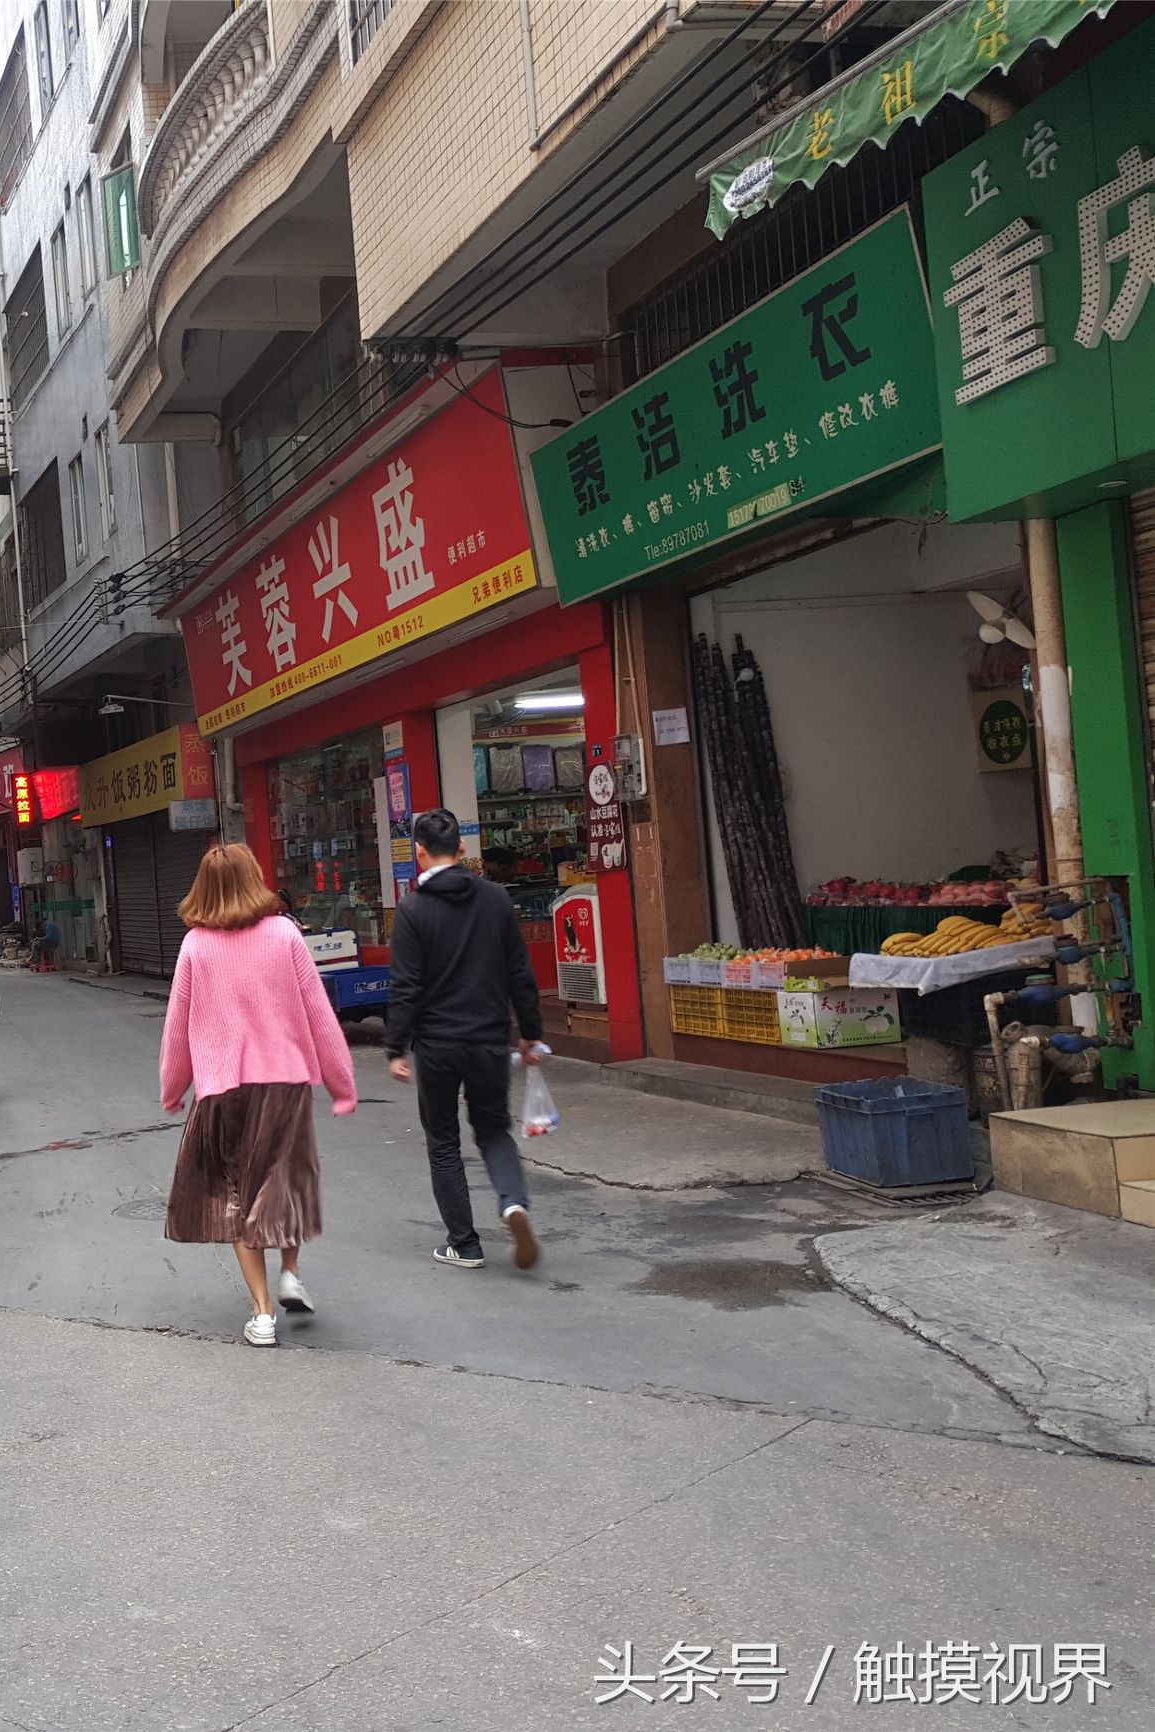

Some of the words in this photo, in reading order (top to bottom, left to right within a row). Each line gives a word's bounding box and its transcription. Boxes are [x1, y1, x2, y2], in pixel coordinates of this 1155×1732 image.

[964, 118, 1060, 217] 正宗
[565, 272, 872, 517] 泰洁洗衣
[447, 528, 486, 566] 便利超市
[644, 519, 710, 561] Tle:89787081
[214, 457, 436, 697] 芙蓉兴盛
[472, 564, 523, 605] 兄弟便利店
[15, 776, 30, 823] 高原拉面
